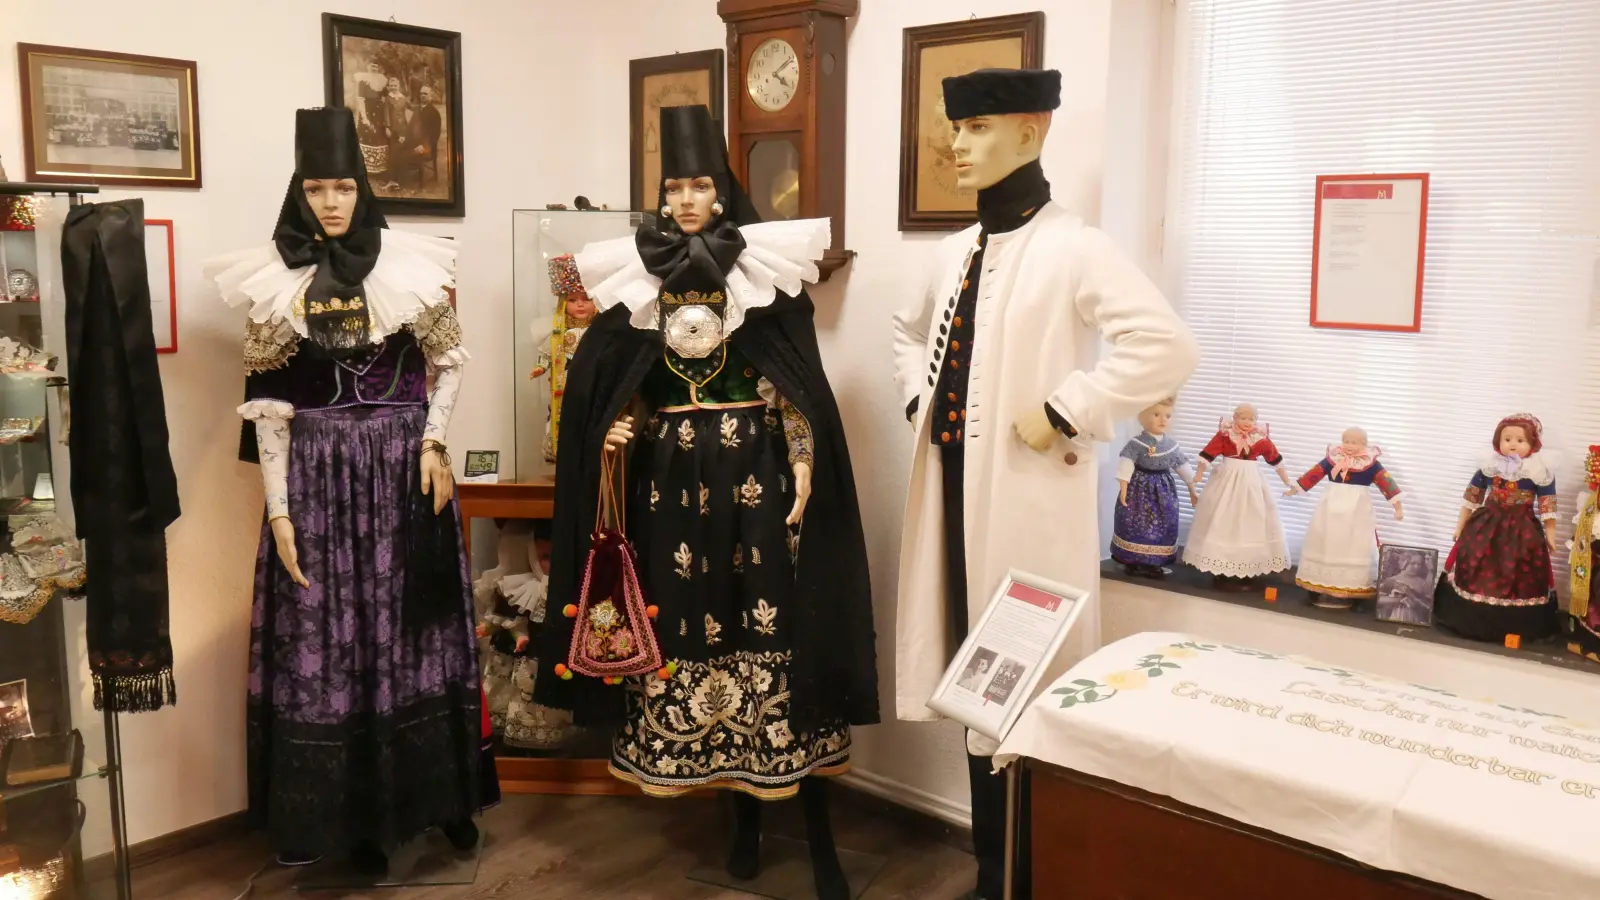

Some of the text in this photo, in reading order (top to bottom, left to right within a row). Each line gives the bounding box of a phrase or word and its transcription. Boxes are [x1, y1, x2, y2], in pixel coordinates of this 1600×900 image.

[1171, 680, 1212, 700] Er
[1210, 693, 1284, 720] wird
[1285, 711, 1355, 738] dich
[1358, 728, 1556, 785] wunderbar
